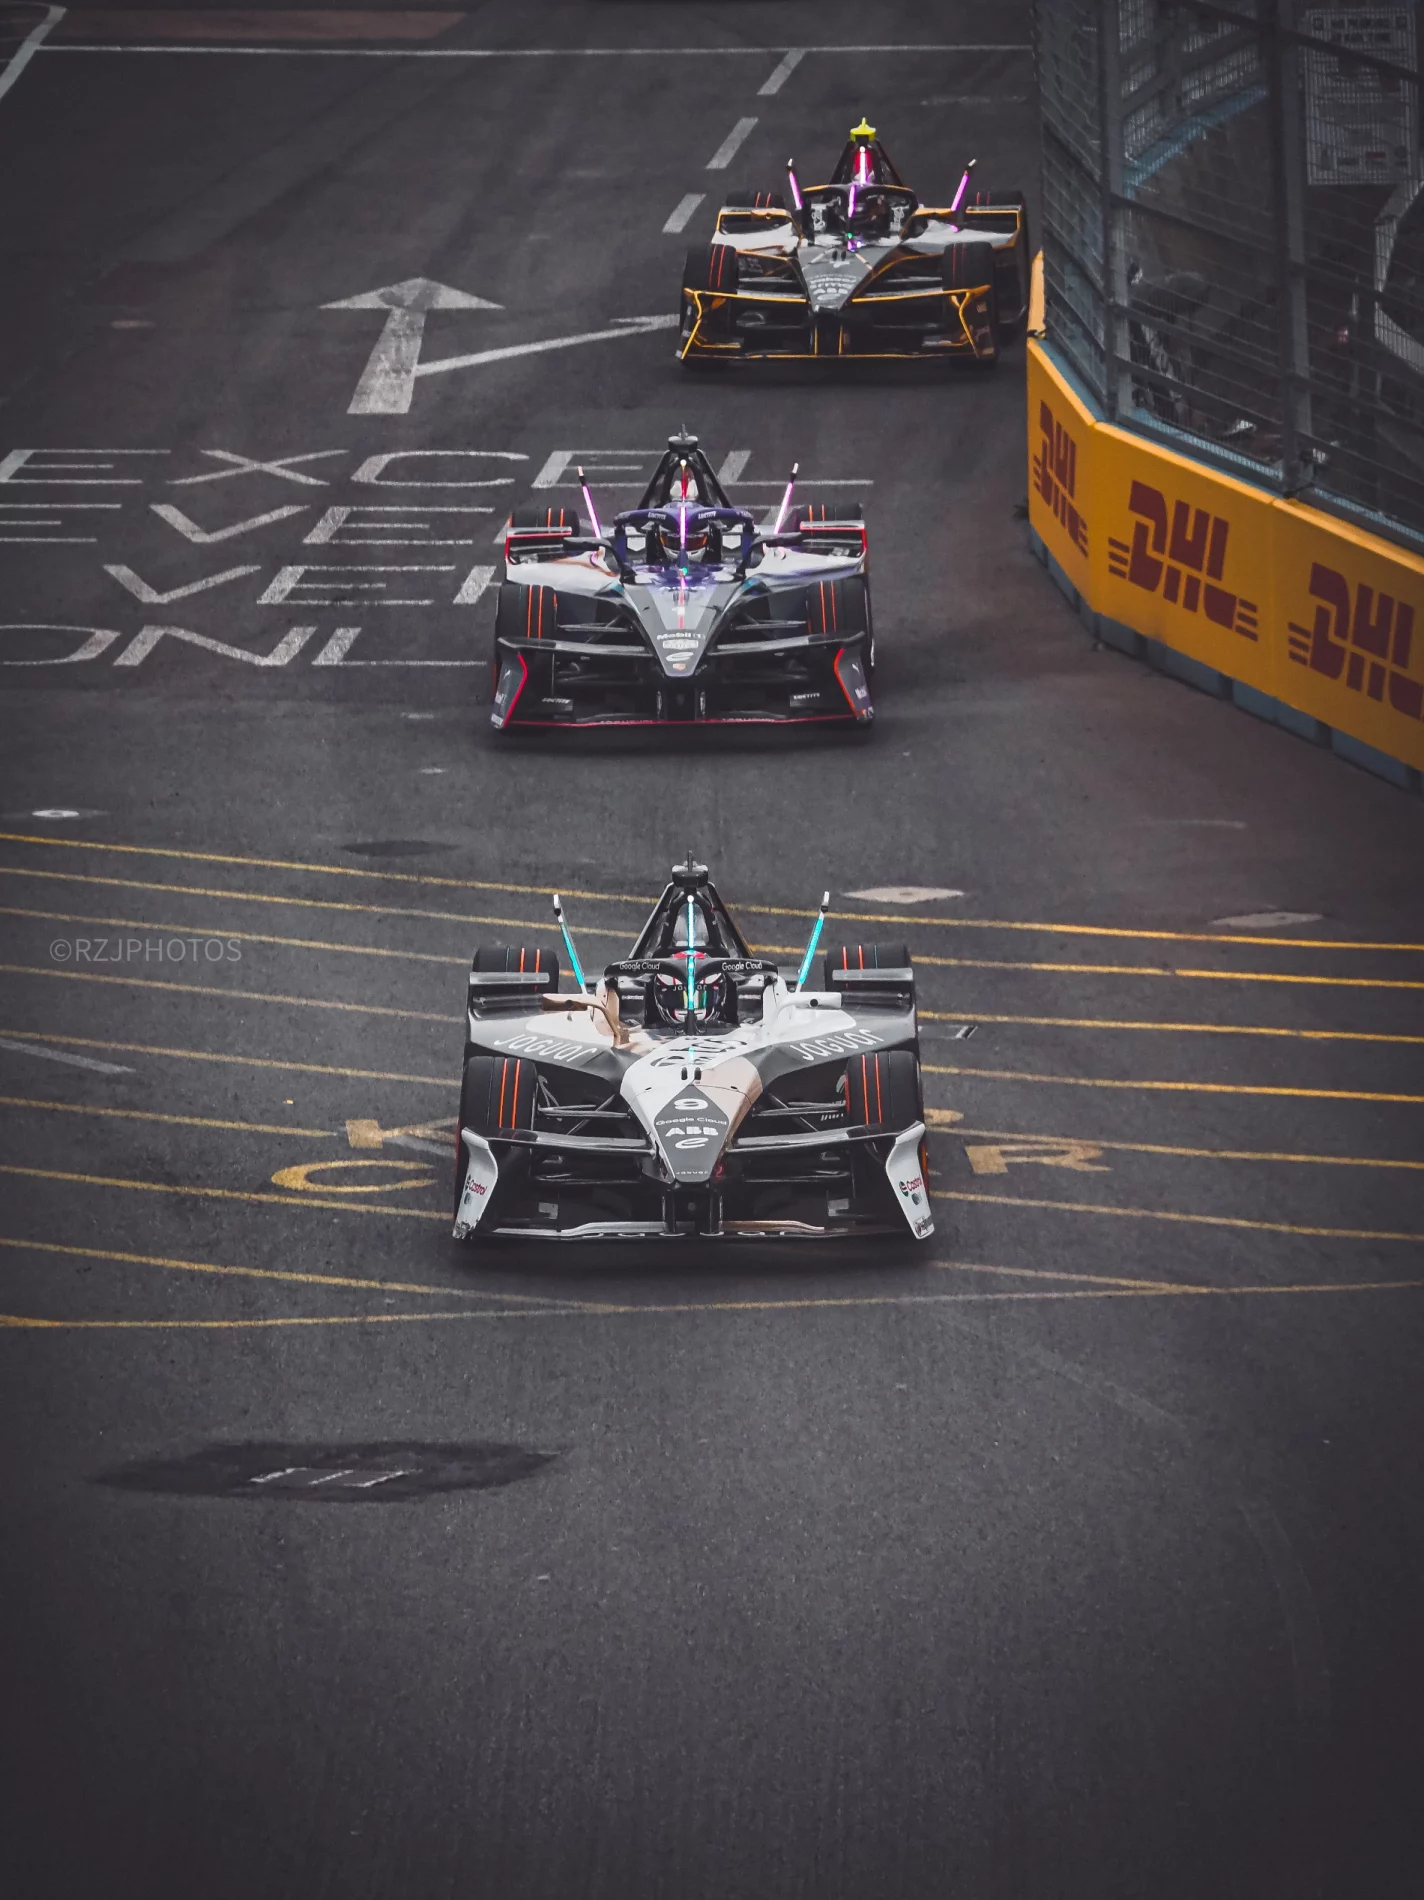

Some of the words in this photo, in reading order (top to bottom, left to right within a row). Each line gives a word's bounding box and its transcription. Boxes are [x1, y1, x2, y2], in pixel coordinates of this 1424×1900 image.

[1036, 400, 1086, 552] DHL
[1118, 480, 1248, 637] DHL
[1299, 562, 1424, 721] DHL
[619, 961, 641, 971] Google
[642, 961, 661, 971] Cloud
[722, 961, 745, 972] Google
[746, 961, 763, 970] Cloud
[674, 1098, 709, 1110] 9
[655, 1117, 695, 1126] Google
[696, 1117, 727, 1126] Cloud
[665, 1126, 719, 1137] ABB
